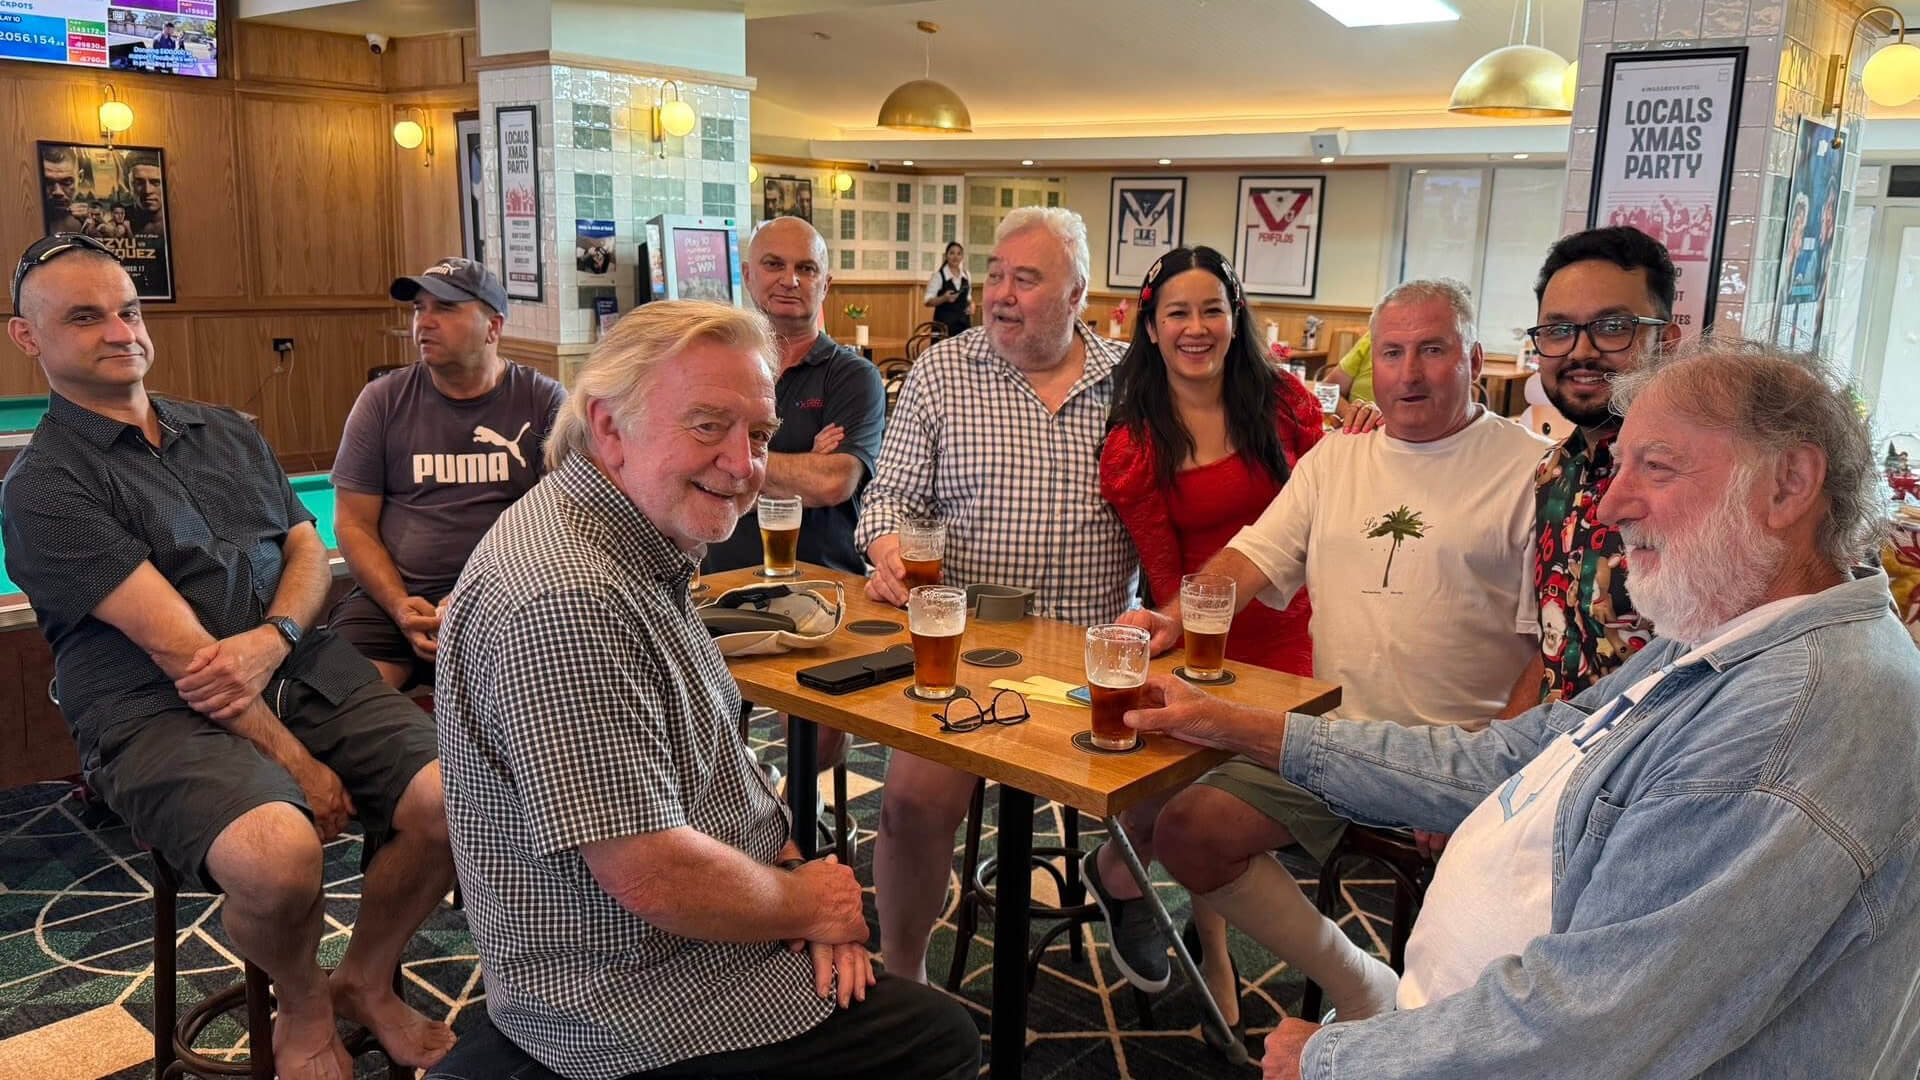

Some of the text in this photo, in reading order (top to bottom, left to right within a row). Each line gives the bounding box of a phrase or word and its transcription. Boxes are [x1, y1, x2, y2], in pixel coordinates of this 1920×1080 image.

[1625, 97, 1713, 125] LOCALS
[505, 130, 529, 144] LOCALS
[1629, 125, 1702, 152] XMAS
[508, 145, 528, 159] XMAS
[507, 160, 529, 174] PARTY
[1624, 153, 1702, 179] PARTY
[95, 237, 136, 248] ZYU
[697, 261, 716, 273] WIN
[412, 452, 510, 484] PUMA
